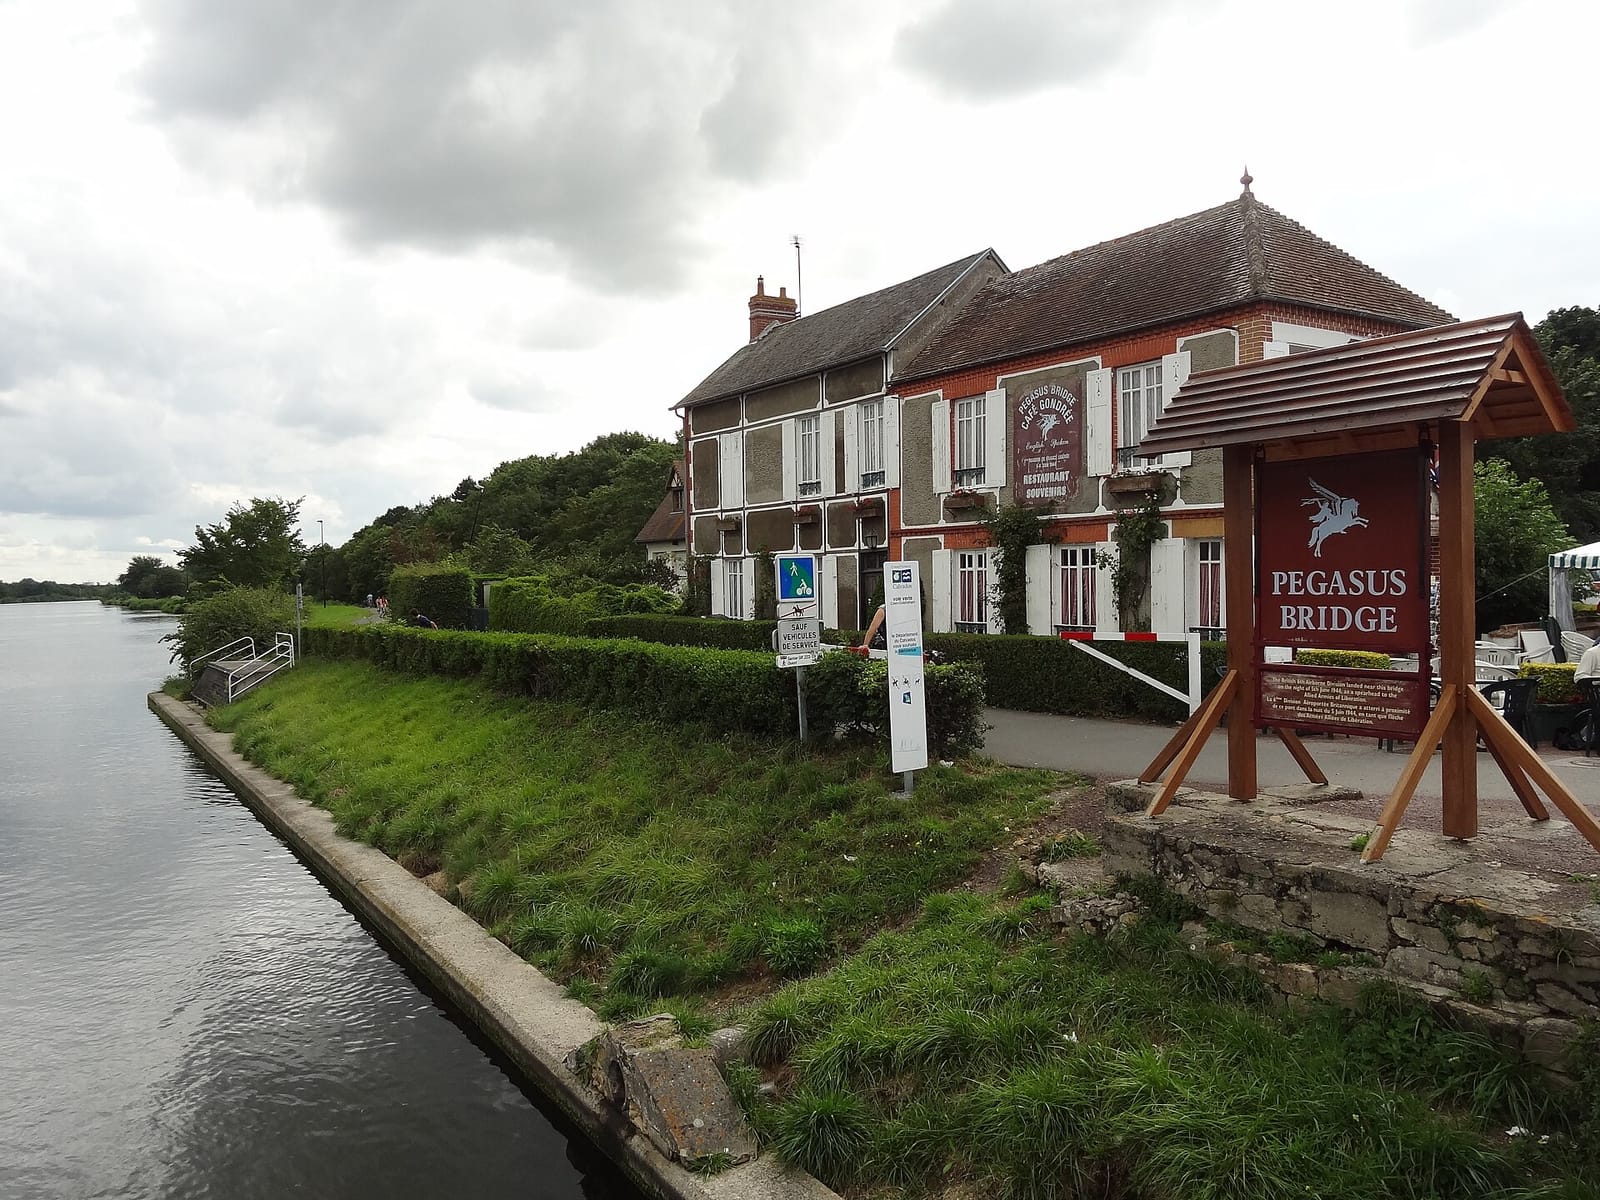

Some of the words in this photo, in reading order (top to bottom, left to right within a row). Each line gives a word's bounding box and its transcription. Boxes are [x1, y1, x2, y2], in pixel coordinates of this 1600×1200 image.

[1018, 385, 1049, 414] PEGASUS
[1050, 384, 1076, 406] BRIDGE
[1021, 403, 1038, 430] CAFÉ
[1039, 398, 1074, 425] GONDRÉE
[1025, 440, 1045, 453] English
[1023, 470, 1070, 484] RESTAURANT
[1026, 486, 1067, 498] SOUVENIRS
[1271, 569, 1407, 596] PEGASUS
[1279, 605, 1398, 633] BRIDGE
[791, 623, 808, 631] SAUF
[782, 632, 817, 641] VEHICULES
[782, 642, 791, 650] DE
[792, 640, 818, 649] SERVICE
[1330, 702, 1358, 710] Britannique
